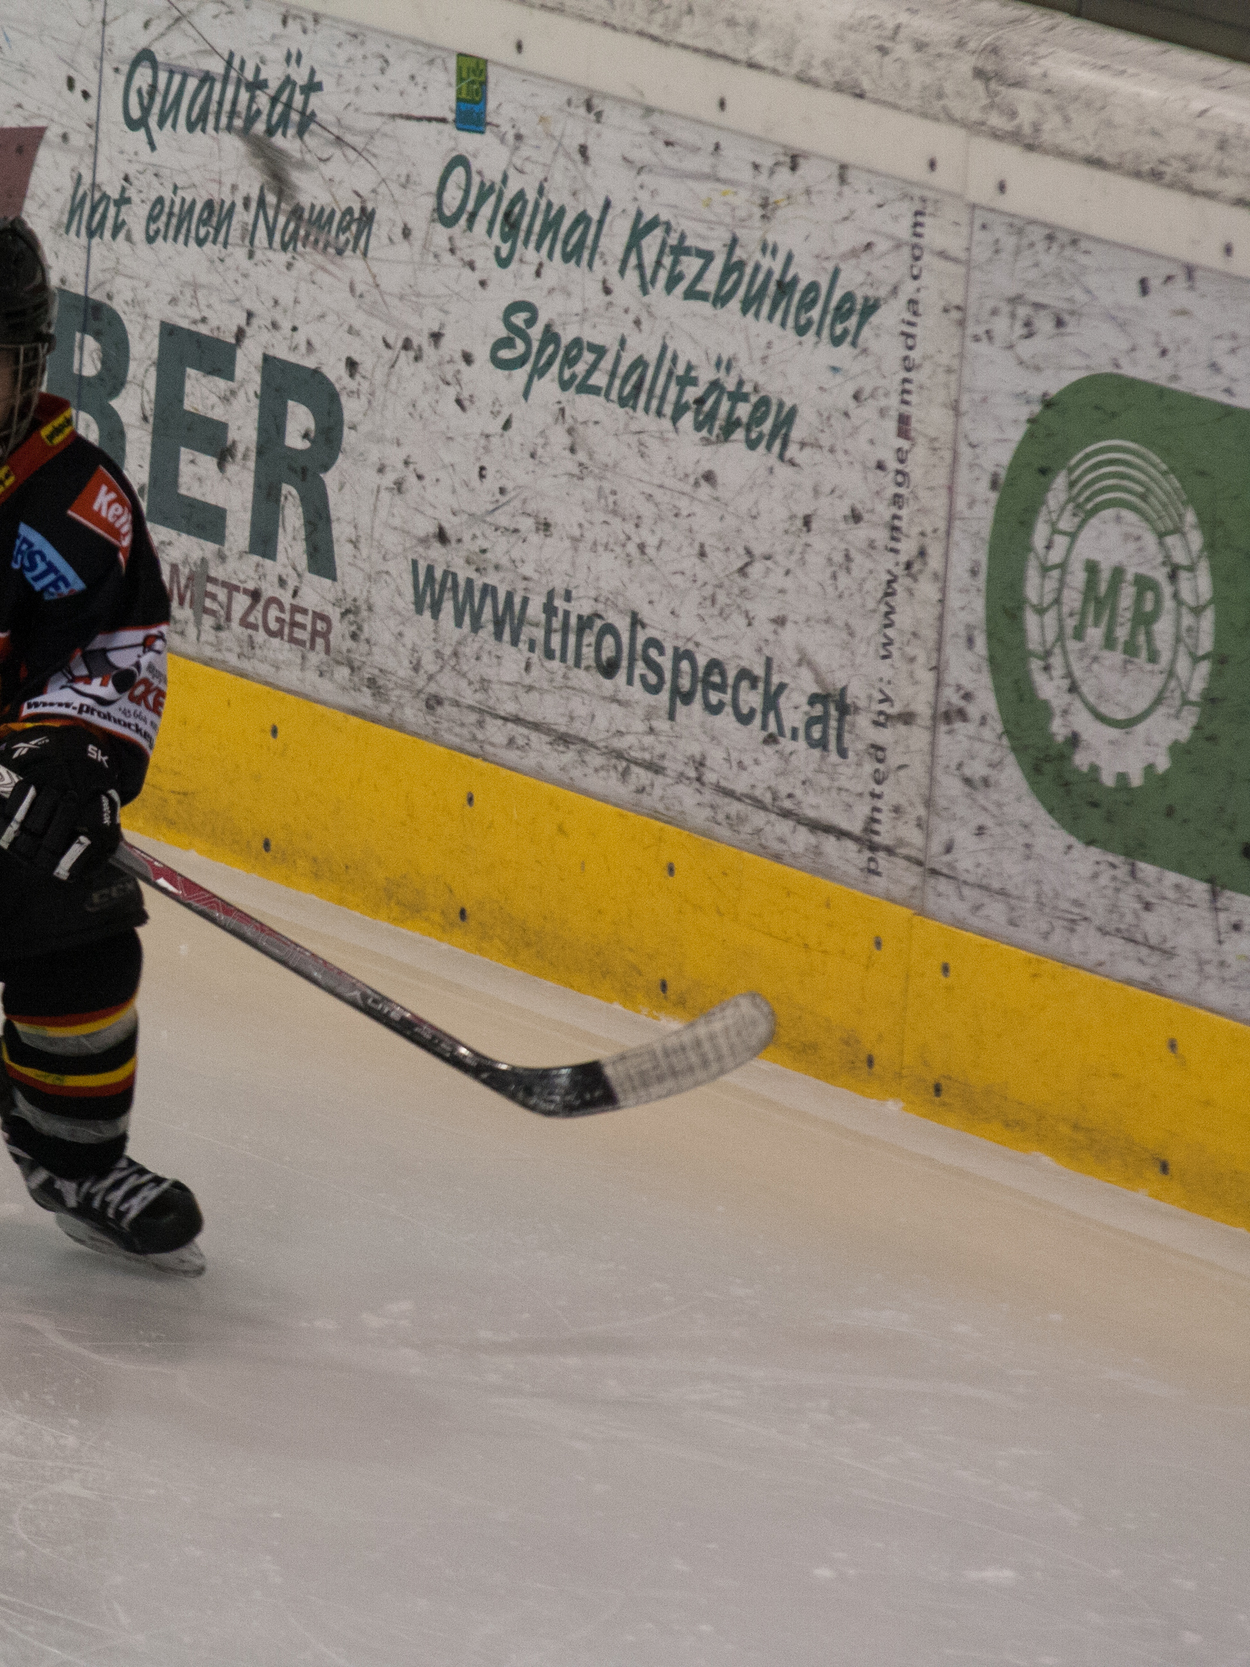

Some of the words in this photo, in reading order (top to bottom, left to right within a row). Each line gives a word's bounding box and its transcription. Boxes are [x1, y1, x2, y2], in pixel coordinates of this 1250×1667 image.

[122, 47, 324, 152] Qualität
[64, 171, 132, 242] hat
[145, 183, 237, 250] einen
[248, 184, 377, 259] Namen
[436, 153, 612, 270] Original
[618, 205, 883, 349] Kitzbüheler
[489, 299, 800, 463] Spezialitäten
[13, 533, 71, 598] RSTE
[168, 562, 334, 657] METZGER
[1072, 557, 1167, 666] MR
[410, 557, 850, 760] www.tirolspeck.at
